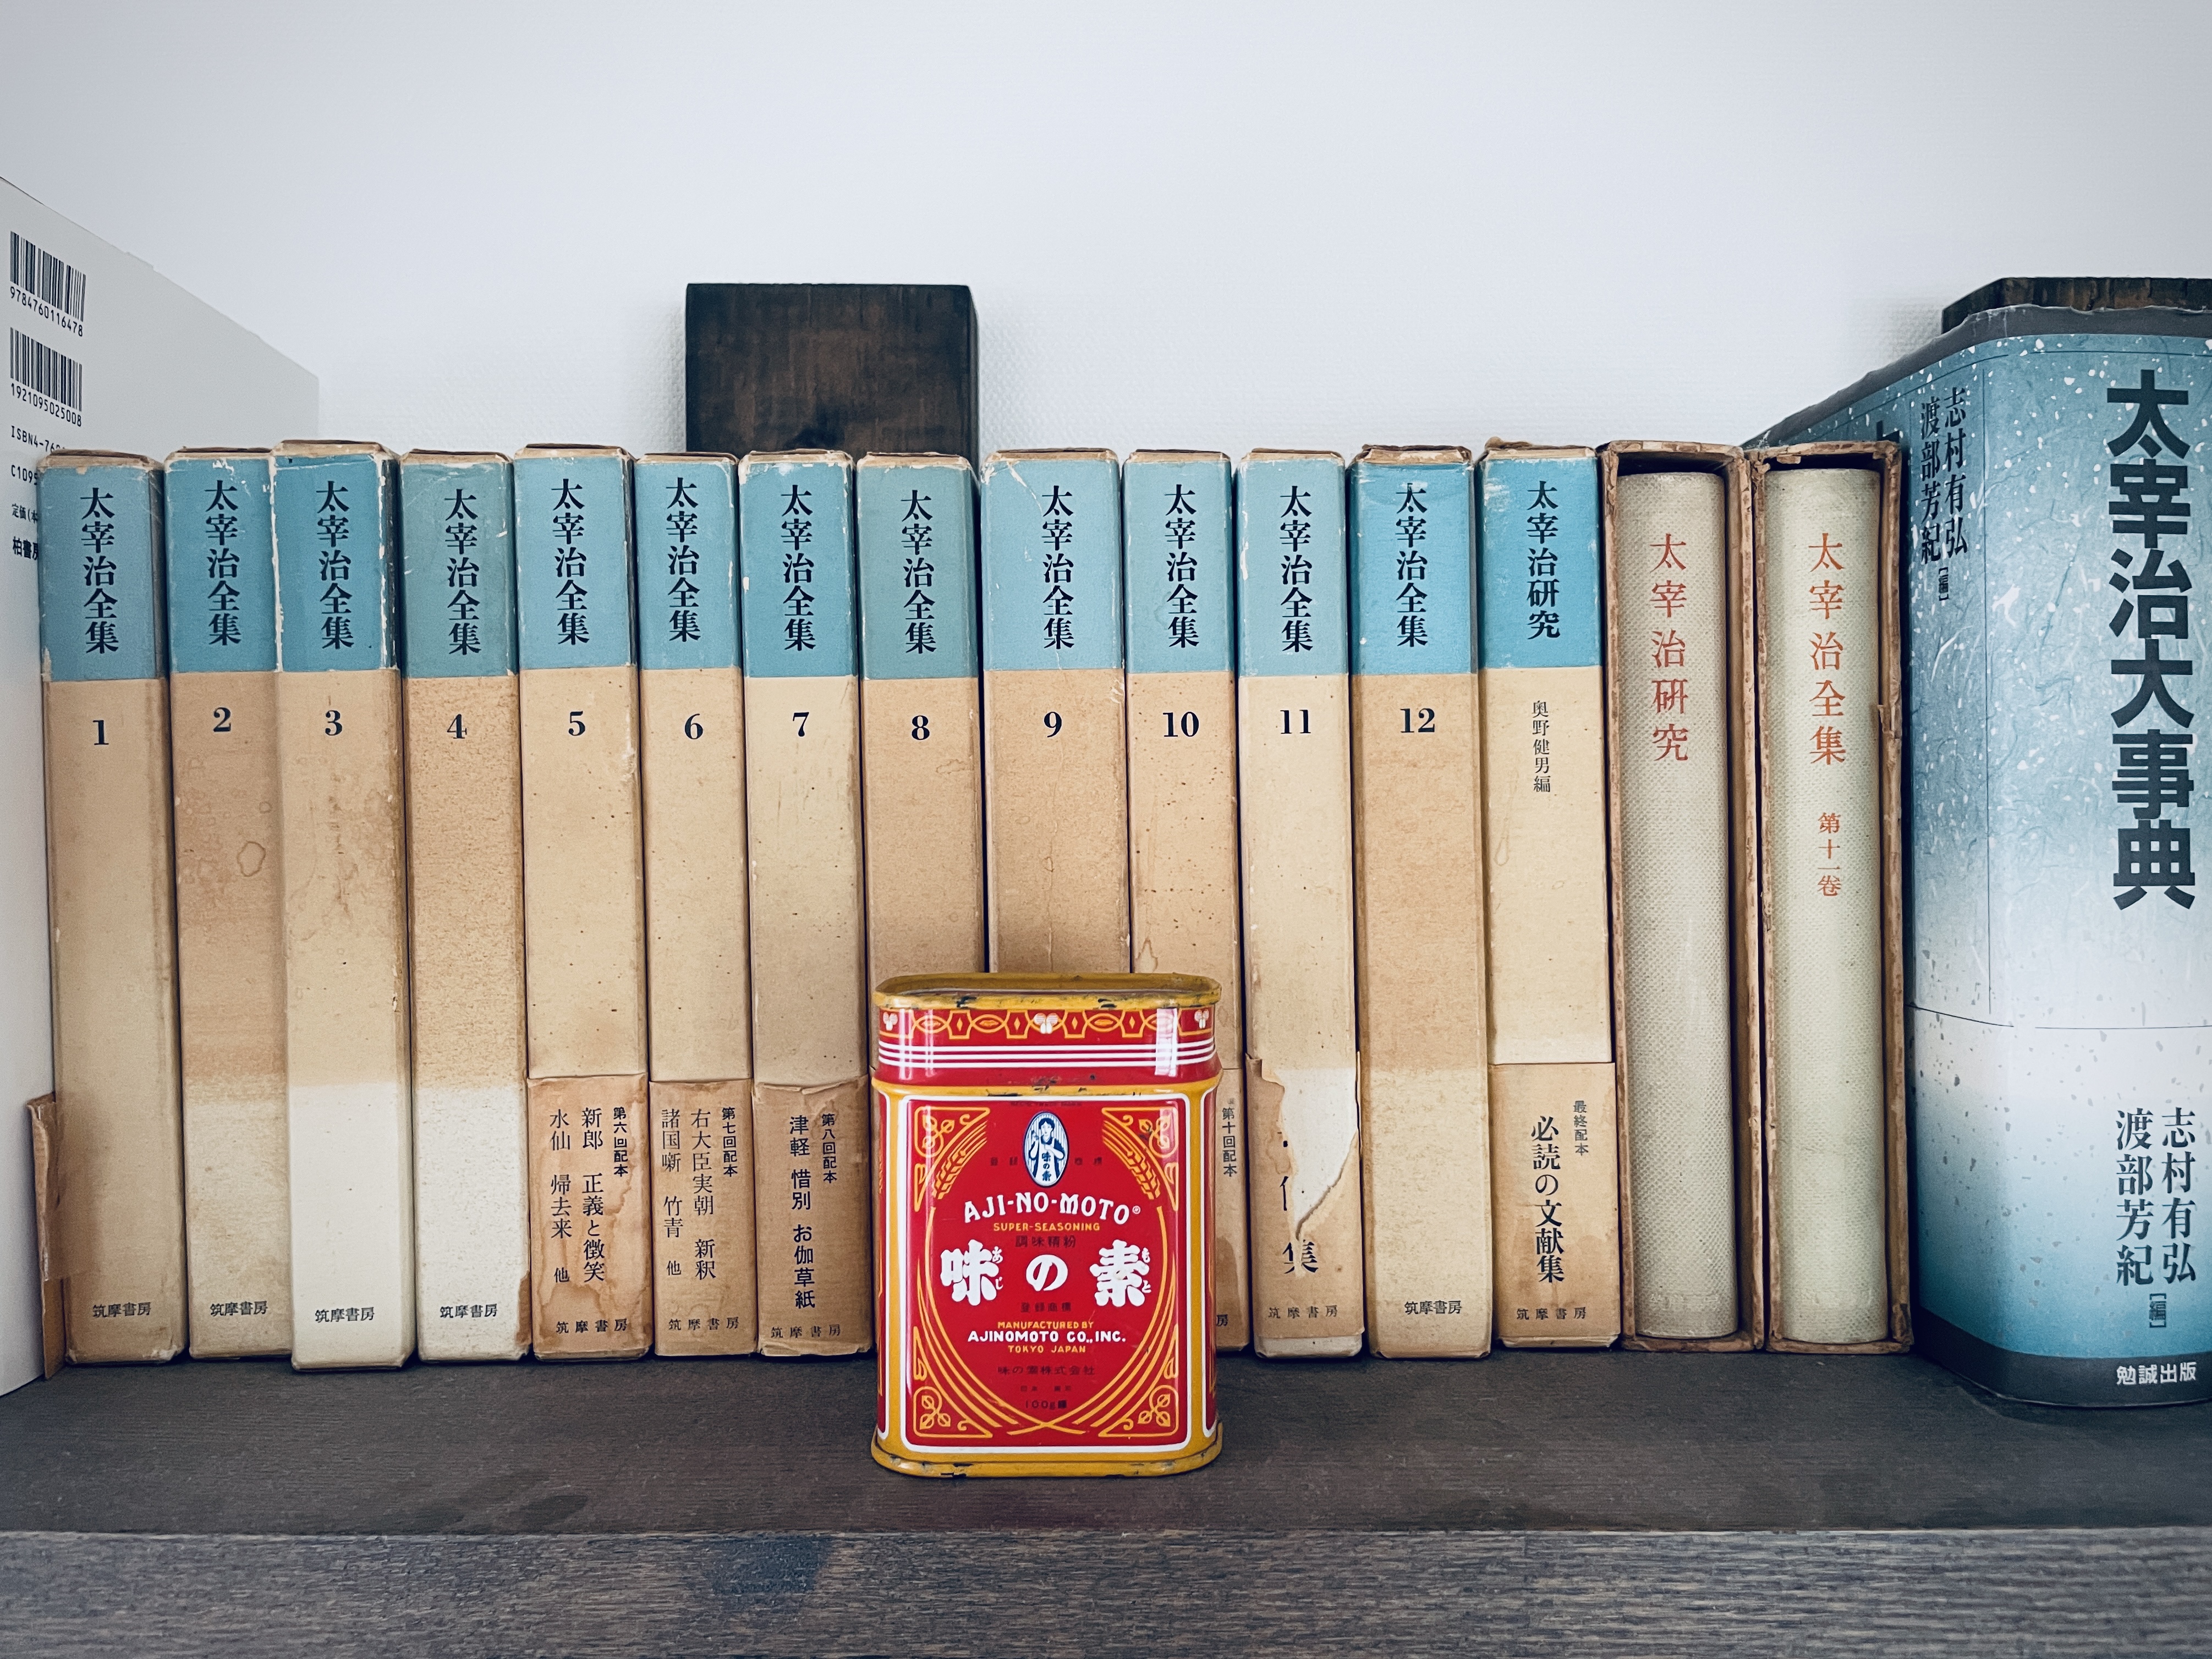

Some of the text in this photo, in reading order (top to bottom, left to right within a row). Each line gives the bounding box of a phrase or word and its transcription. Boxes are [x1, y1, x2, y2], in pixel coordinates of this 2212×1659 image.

[10, 285, 84, 337] 9784760116478
[10, 383, 82, 427] 1921095025008
[11, 425, 65, 454] ISBN4-76
[1920, 396, 1942, 564] 渡部芳紀
[1944, 387, 1968, 558] 志村有弘
[80, 487, 119, 654] 太宰治全集
[205, 480, 241, 646] 太宰治全集
[316, 480, 354, 650] 太宰治全集
[444, 488, 481, 656] 太宰治全集
[551, 478, 590, 645] 太宰治全集
[666, 477, 701, 642] 太宰治全集
[781, 484, 816, 651] 太宰治全集
[901, 490, 937, 654] 太宰治全集
[1042, 485, 1074, 650] 太宰治全集
[1165, 484, 1199, 649] 太宰治全集
[1280, 485, 1313, 653] 太宰治全集
[1396, 482, 1428, 647] 太宰治全集
[1526, 480, 1561, 640] 太宰治研究
[1650, 533, 1688, 761] 太宰治研究
[1809, 532, 1846, 765] 太宰治全集
[2106, 369, 2197, 911] 太宰治大事典
[92, 719, 109, 745] 1
[213, 707, 231, 732] 2
[325, 710, 343, 736] 3
[447, 713, 467, 739] 4
[568, 711, 586, 737] 5
[684, 713, 704, 740] 6
[792, 712, 809, 737] 7
[912, 715, 930, 740] 8
[1044, 711, 1062, 738] 9
[1162, 711, 1199, 737] 10
[1280, 709, 1311, 734] 11
[1400, 708, 1435, 733] 12
[1532, 700, 1551, 793] 奥野健男編
[581, 1107, 603, 1150] 新郎
[613, 1106, 629, 1177] 第六回配本
[722, 1107, 738, 1177] 第七回配本
[821, 1113, 837, 1184] 第八回配本
[1222, 1107, 1237, 1177] 第十回配本
[1573, 1100, 1589, 1156] 最終配本
[550, 1108, 572, 1283] 水仙 帰去来 他
[662, 1108, 683, 1276] 諸国噺 竹青 他
[690, 1108, 716, 1281] 右大臣実朝 新釈
[789, 1114, 815, 1309] 津軽 惜別 お伽草紙
[1531, 1116, 1565, 1283] 必読の文献集
[2116, 1108, 2154, 1287] 渡部芳紀
[2162, 1107, 2197, 1284] 志村有弘
[994, 1222, 1100, 1231] SUPER-SEASONING
[92, 1302, 151, 1319] 筑摩書房
[210, 1300, 268, 1317] 筑摩書房
[315, 1306, 375, 1323] 筑摩書房
[440, 1303, 497, 1319] 筑摩書房
[556, 1317, 628, 1334] 筑摩書房
[668, 1316, 739, 1331] 筑摩書房
[771, 1323, 841, 1338] 筑摩書房
[997, 1321, 1079, 1330] MANUFACTURED
[1267, 1305, 1337, 1319] 筑摩書房
[1404, 1300, 1462, 1315] 筑摩書房
[1516, 1306, 1586, 1320] 筑摩書房
[968, 1330, 1058, 1343] AJINOMOTO
[1095, 1330, 1126, 1342] INC.
[1008, 1345, 1044, 1354] TOKYO
[2116, 1361, 2197, 1385] 勉誠出版
